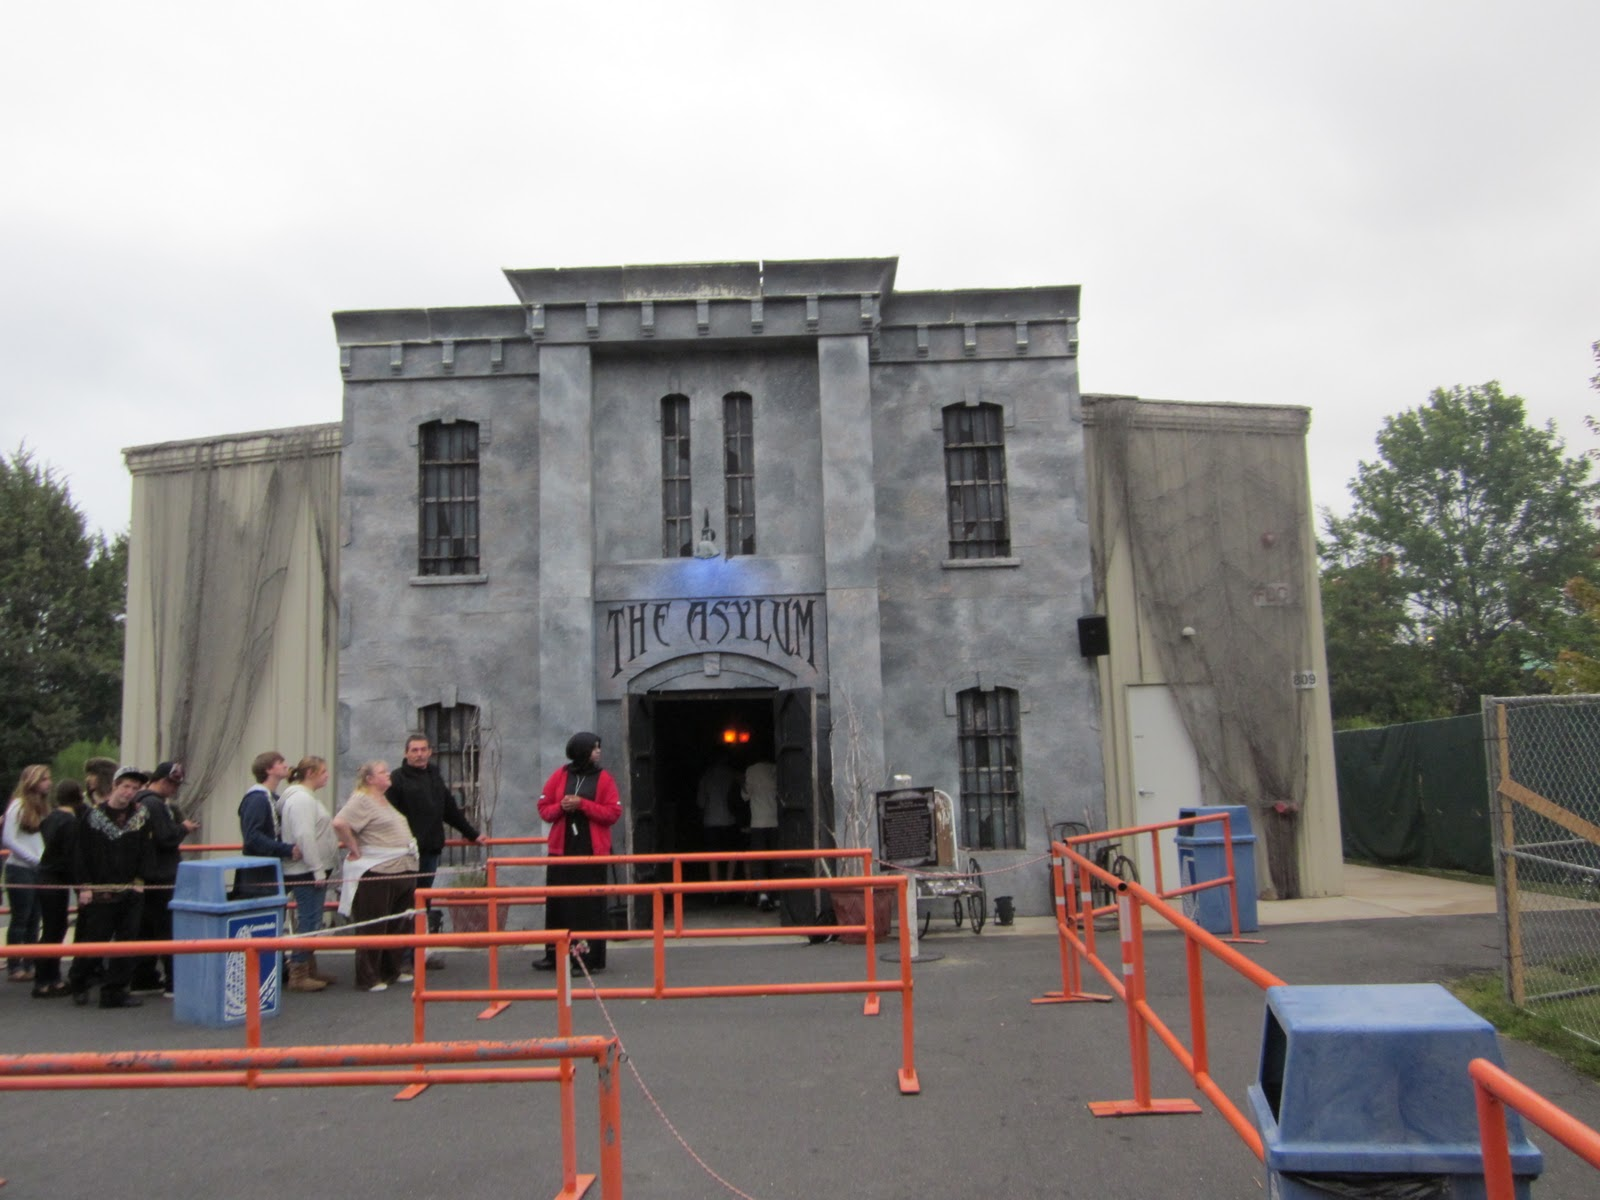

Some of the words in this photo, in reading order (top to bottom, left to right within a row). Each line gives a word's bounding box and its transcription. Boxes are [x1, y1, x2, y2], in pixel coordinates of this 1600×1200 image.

[606, 601, 672, 678] THE
[686, 598, 819, 674] ASYLUM
[1293, 673, 1316, 686] 809
